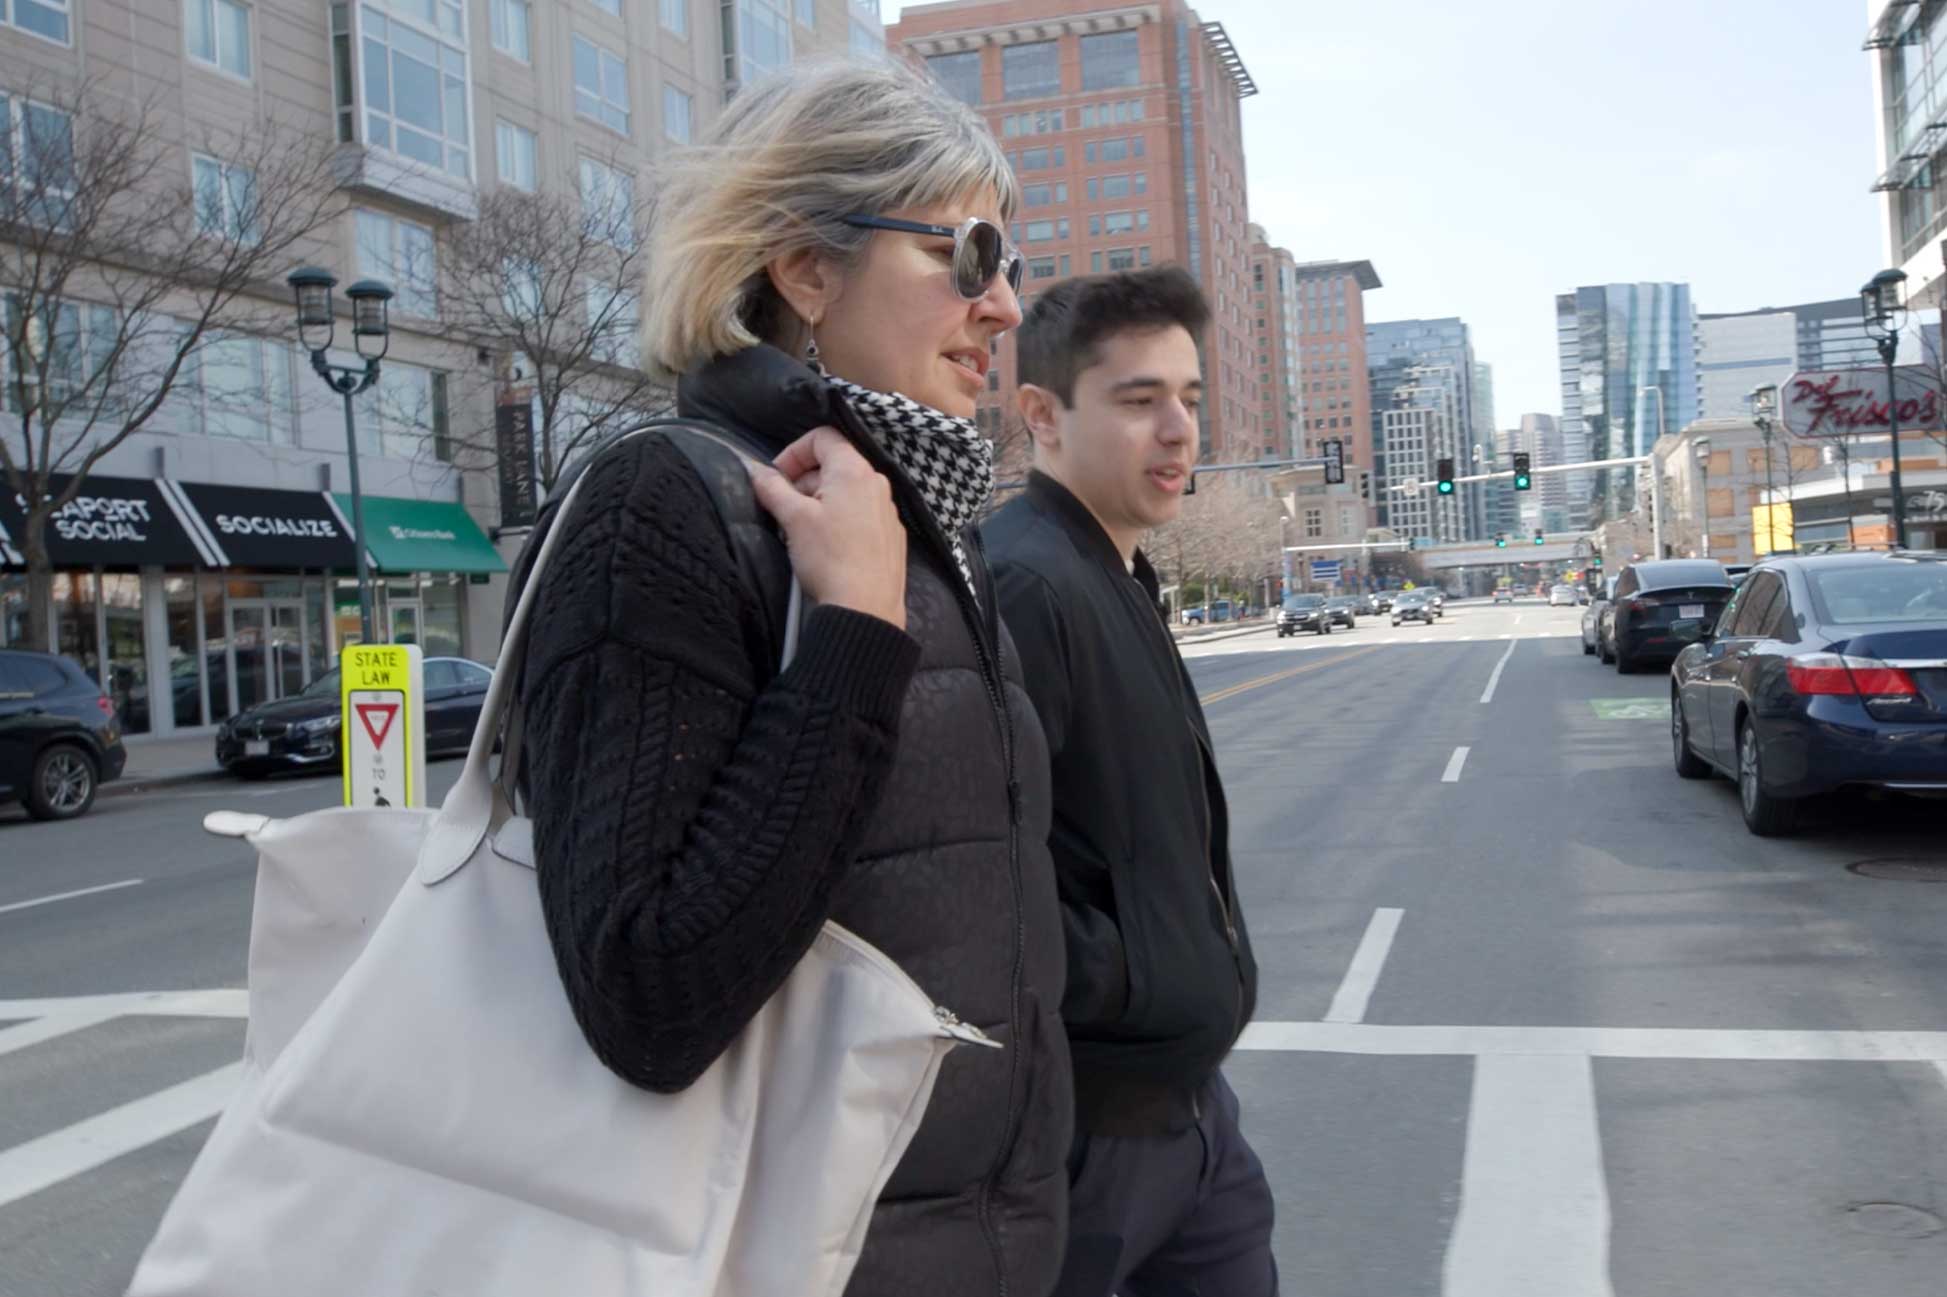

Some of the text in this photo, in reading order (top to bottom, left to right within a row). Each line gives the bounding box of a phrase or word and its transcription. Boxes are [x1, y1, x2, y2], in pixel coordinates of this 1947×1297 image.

[1791, 374, 1840, 404] Del
[512, 411, 527, 453] PARK
[515, 458, 530, 505] LANE
[15, 493, 150, 522] APORT
[55, 519, 147, 541] SOCIAL
[216, 514, 338, 538] SOCIALIZE
[355, 652, 398, 667] STATE
[361, 671, 391, 685] LAW
